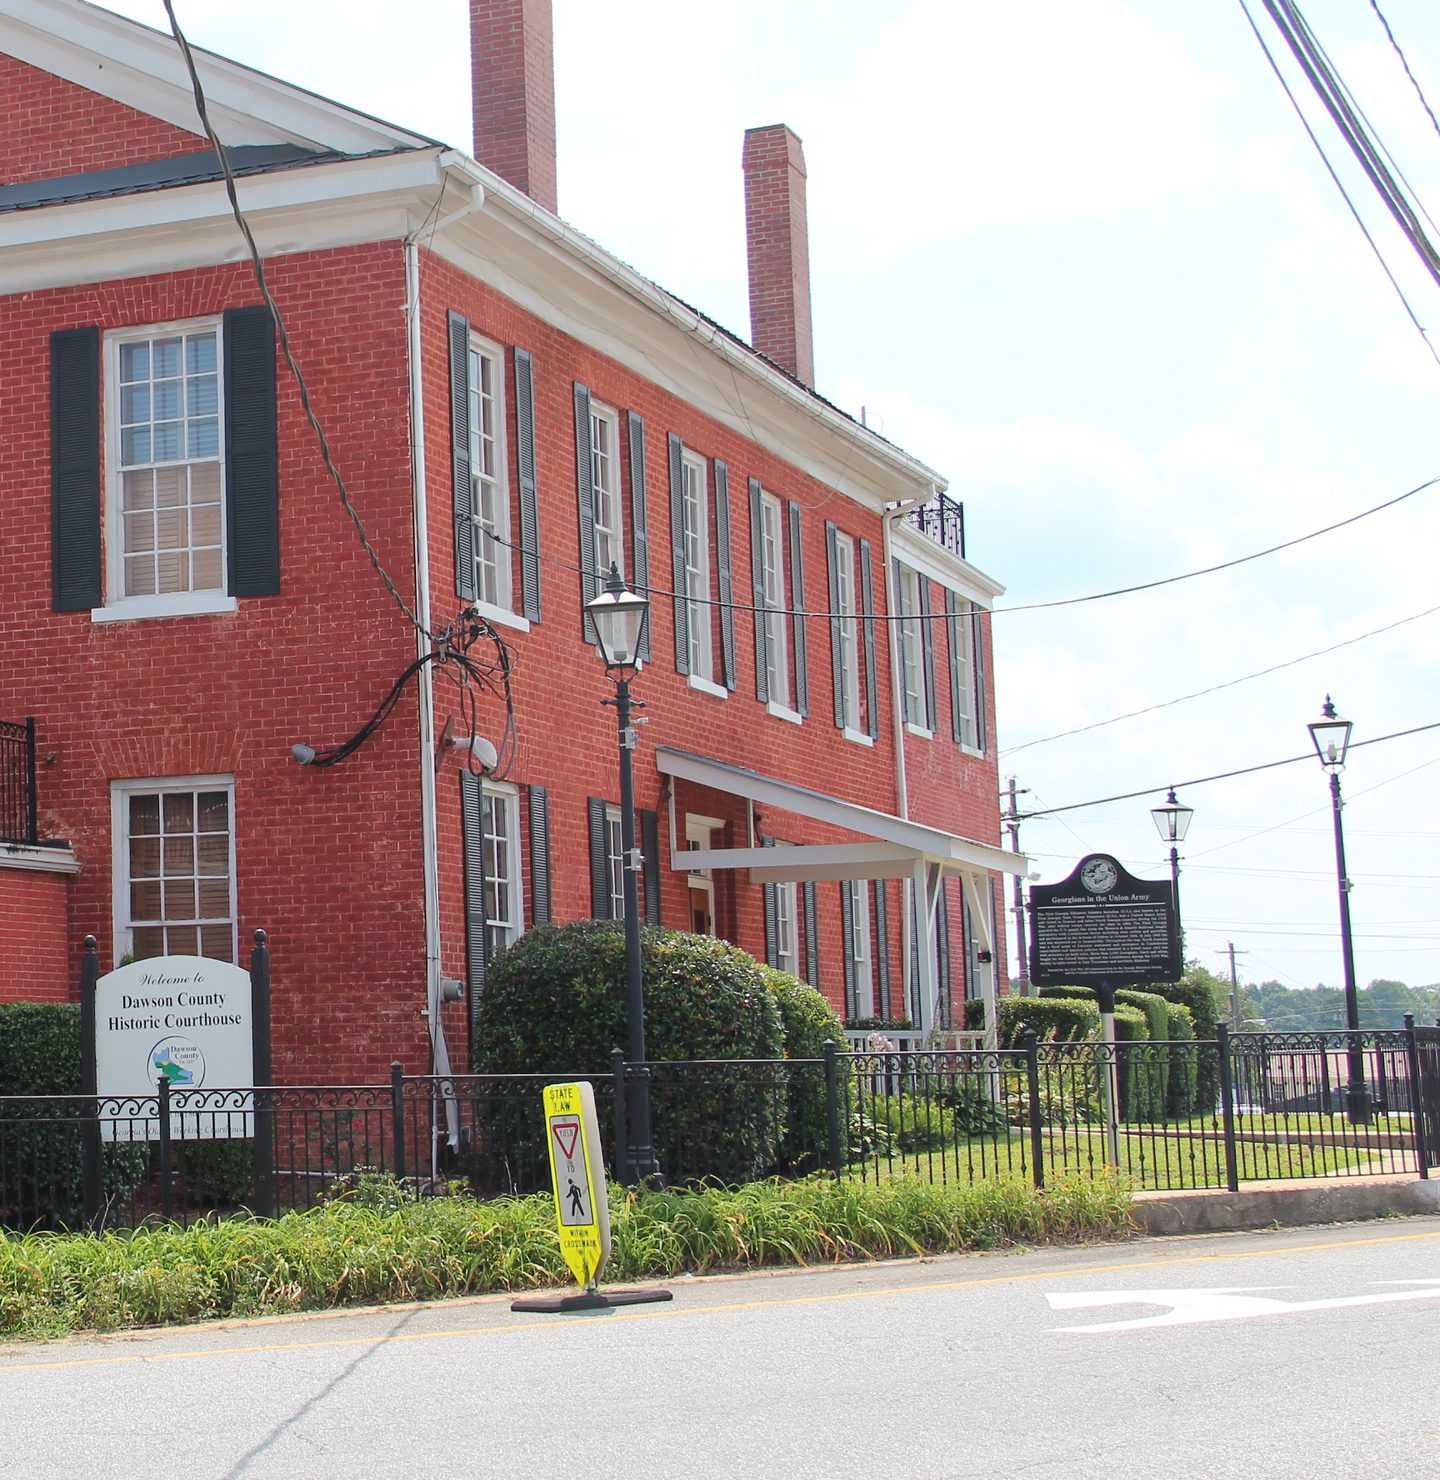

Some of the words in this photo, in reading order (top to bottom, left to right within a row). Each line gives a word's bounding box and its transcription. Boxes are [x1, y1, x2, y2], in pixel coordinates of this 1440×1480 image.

[1051, 896, 1086, 904] Georgians
[1131, 894, 1150, 902] Army
[140, 973, 189, 985] Welcome
[193, 972, 205, 983] to
[122, 995, 173, 1009] Dawson
[177, 992, 226, 1008] County
[108, 1015, 160, 1031] Historic
[164, 1013, 242, 1029] Courthouse
[175, 1052, 199, 1060] County
[549, 1088, 573, 1100] STATE
[554, 1101, 571, 1112] LAW
[560, 1129, 574, 1138] YIELD
[567, 1165, 575, 1174] TO
